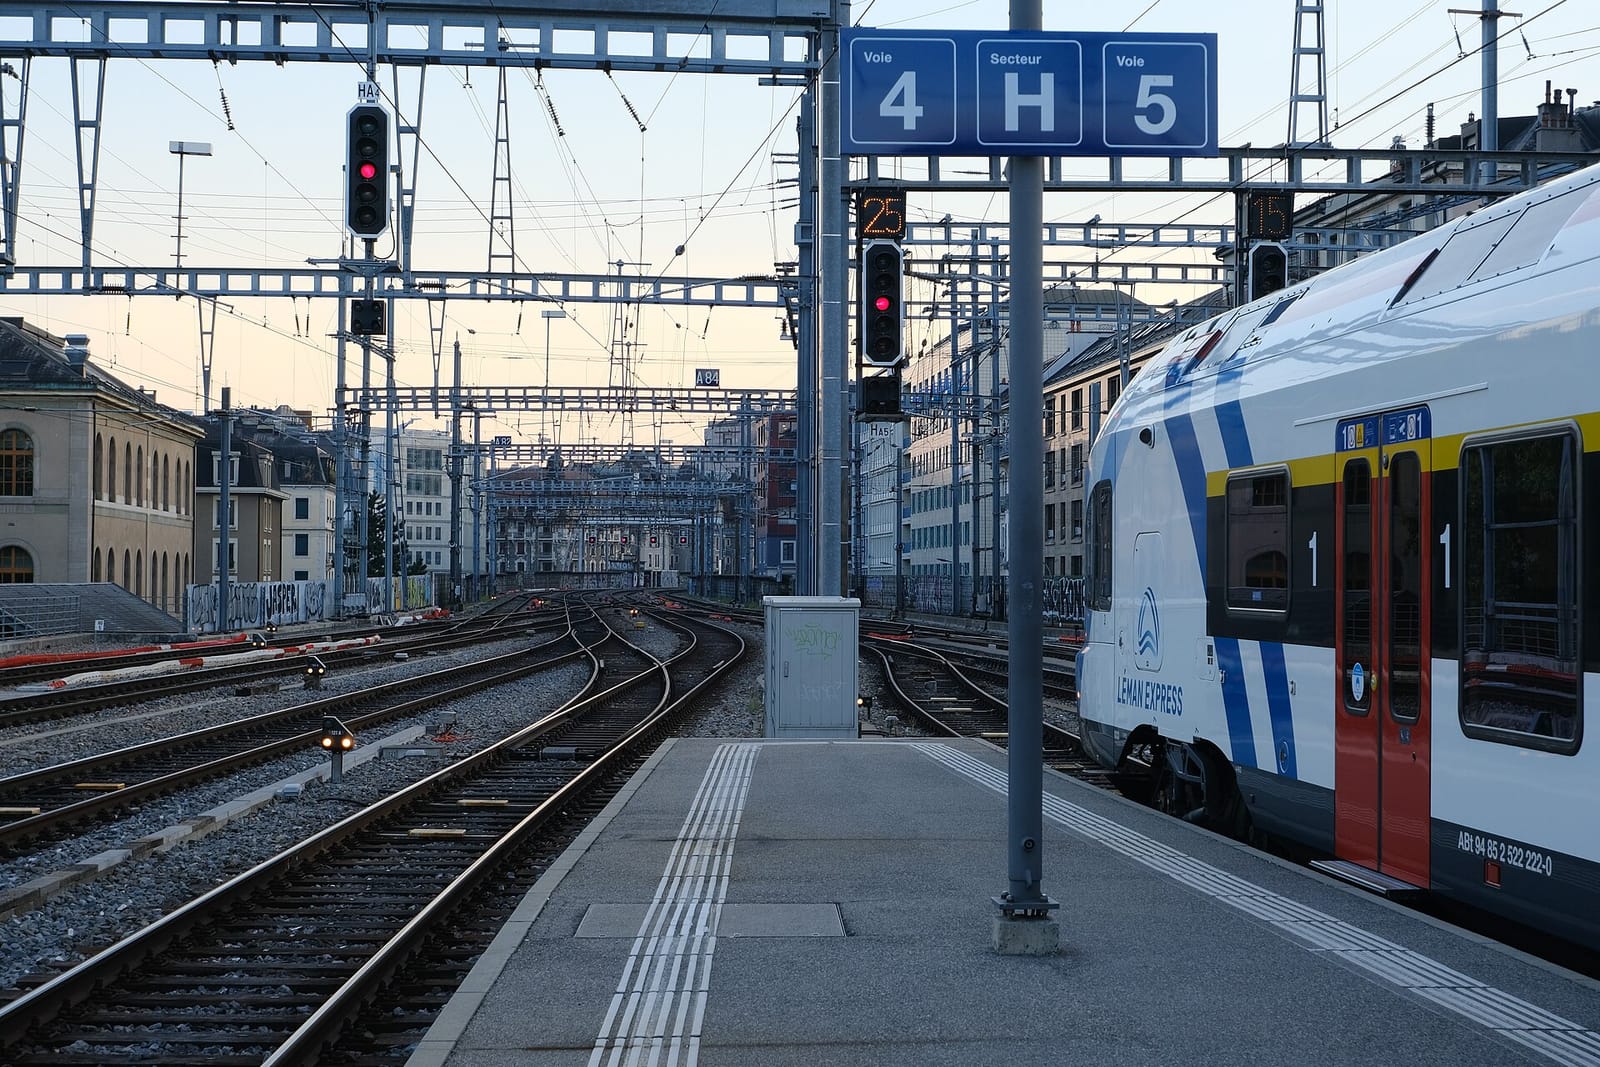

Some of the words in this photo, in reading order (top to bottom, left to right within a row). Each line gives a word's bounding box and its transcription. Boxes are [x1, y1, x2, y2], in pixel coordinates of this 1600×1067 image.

[864, 52, 892, 63] Voie
[990, 53, 1042, 65] Secteur
[1116, 55, 1145, 67] Voie
[879, 71, 923, 130] 4
[1004, 72, 1055, 132] H
[1134, 74, 1177, 135] 5
[863, 198, 902, 233] 25
[1254, 196, 1285, 234] 15
[696, 371, 703, 384] A
[705, 371, 719, 384] 84
[1309, 531, 1317, 587] 1
[1440, 523, 1450, 588] 1
[266, 583, 297, 620] JASPER
[1145, 681, 1183, 716] EXPRESS
[1458, 831, 1474, 853] ABt
[1475, 836, 1486, 856] 94
[1487, 839, 1498, 860] 85
[1500, 843, 1506, 862] 2
[1507, 845, 1524, 868] 522
[1525, 850, 1552, 877] 222-0
